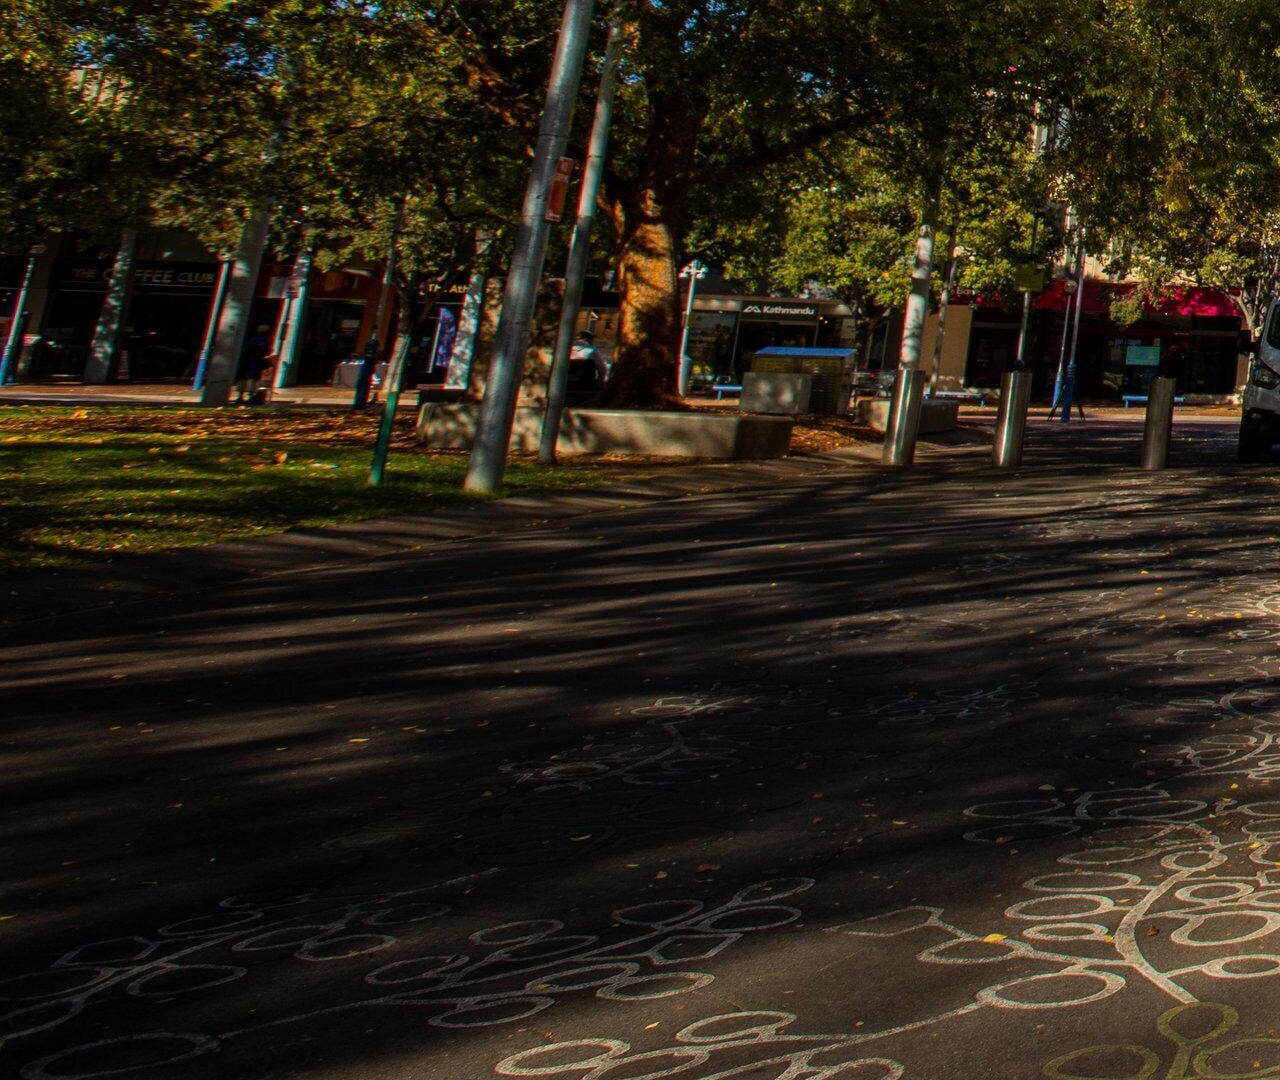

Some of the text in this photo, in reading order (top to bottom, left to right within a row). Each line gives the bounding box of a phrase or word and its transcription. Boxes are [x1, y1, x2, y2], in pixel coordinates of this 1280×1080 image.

[72, 268, 214, 283] THE CFFEE CLUB
[763, 305, 815, 315] Kathmandu
